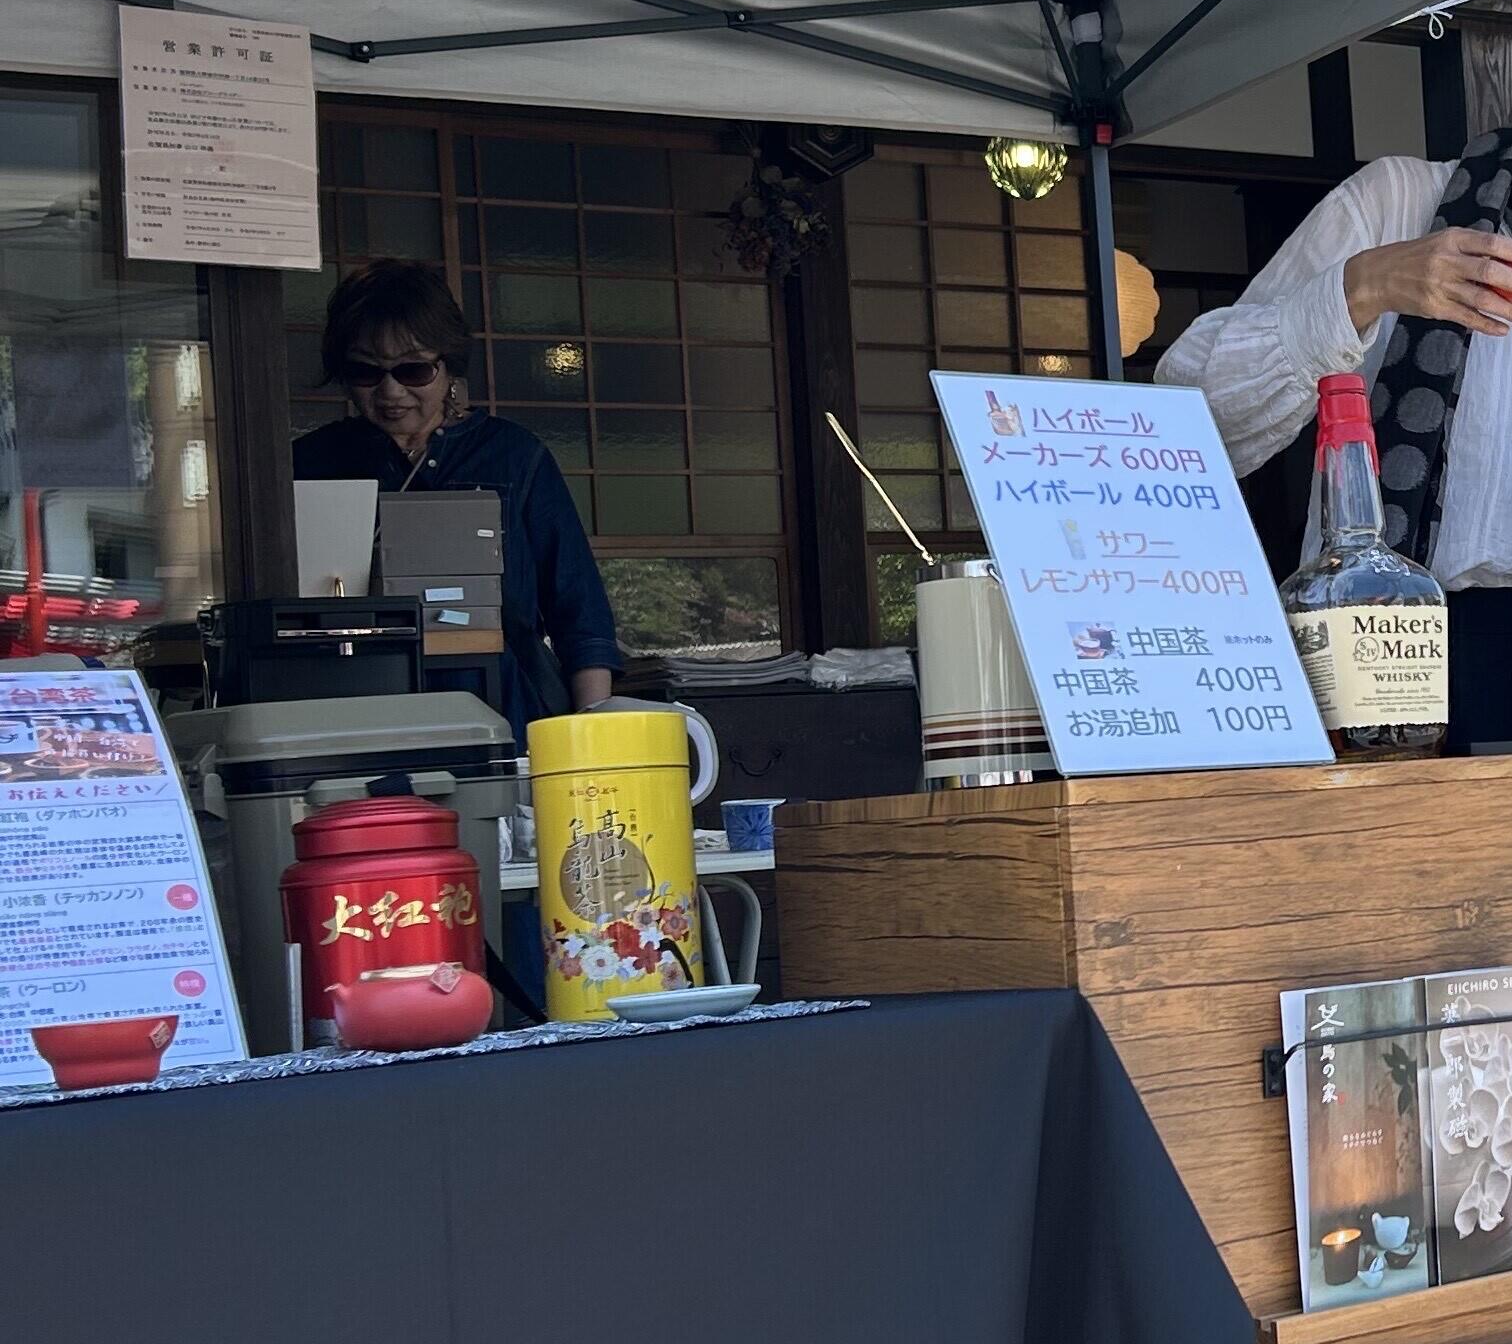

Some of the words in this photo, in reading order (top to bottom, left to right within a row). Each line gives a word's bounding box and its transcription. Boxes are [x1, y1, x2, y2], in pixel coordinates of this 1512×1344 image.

[1032, 406, 1154, 435] ハイボール
[981, 442, 1110, 468] メーカーズ
[1120, 447, 1207, 474] 600円
[995, 479, 1122, 506] ハイボール
[1134, 484, 1220, 511] 400円
[1096, 529, 1174, 555] サワー
[1351, 615, 1443, 635] Maker's
[1130, 627, 1209, 656] 中国茶
[1382, 640, 1443, 660] Mark
[1053, 668, 1139, 696] 中国茶
[1196, 666, 1283, 692] 400円
[1373, 672, 1432, 682] WHISKY
[1067, 708, 1180, 738] お湯追加
[1207, 705, 1292, 733] 100円
[1448, 978, 1498, 996] EIICHIRO
